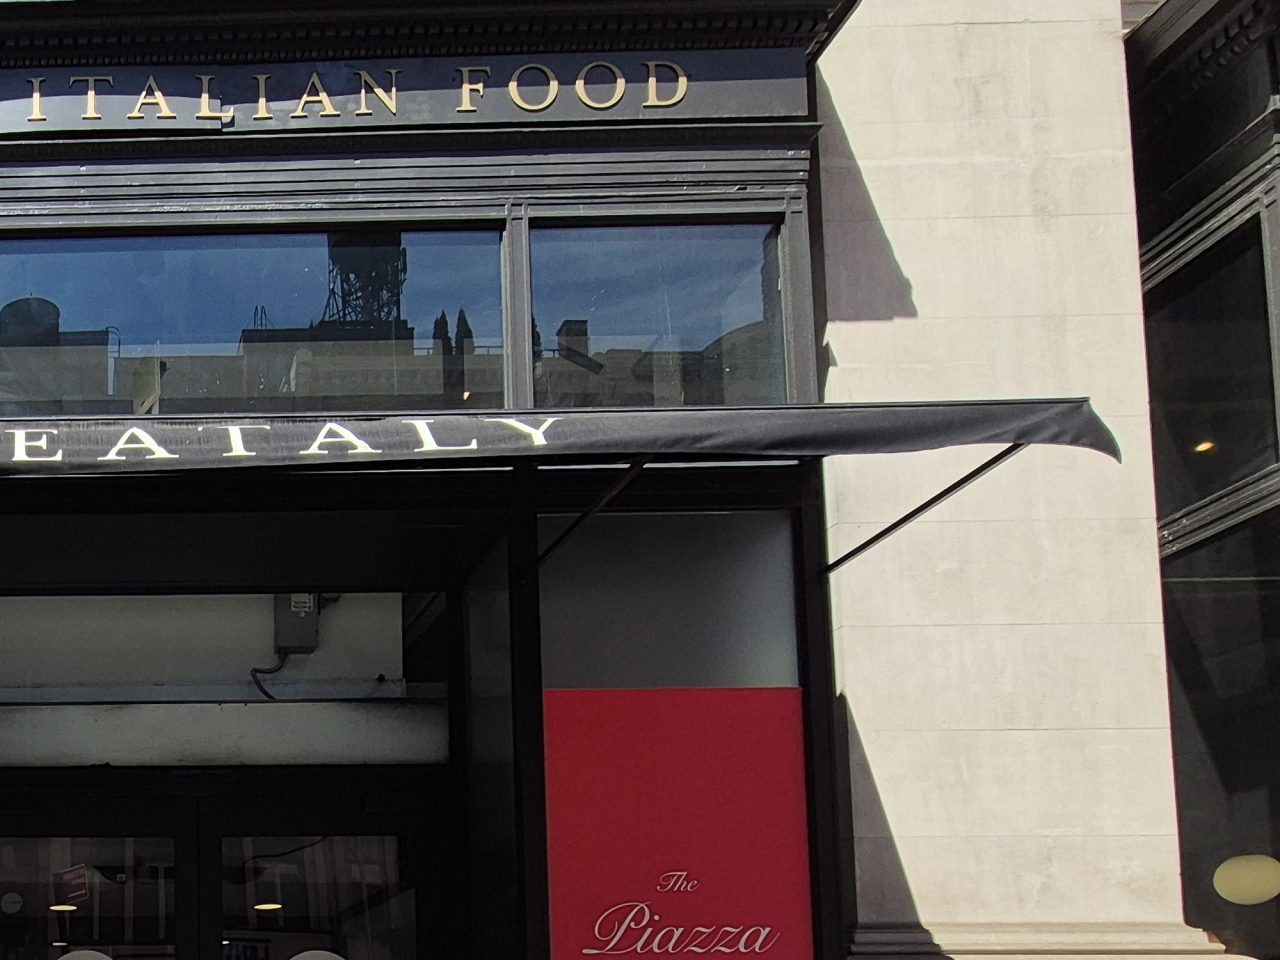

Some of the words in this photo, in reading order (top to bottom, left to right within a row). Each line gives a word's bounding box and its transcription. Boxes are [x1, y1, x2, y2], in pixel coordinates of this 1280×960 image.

[26, 68, 403, 121] ITALIAN
[455, 61, 689, 112] FOOD
[4, 418, 566, 462] EATALY
[657, 871, 699, 892] The
[581, 901, 781, 954] Piazza
